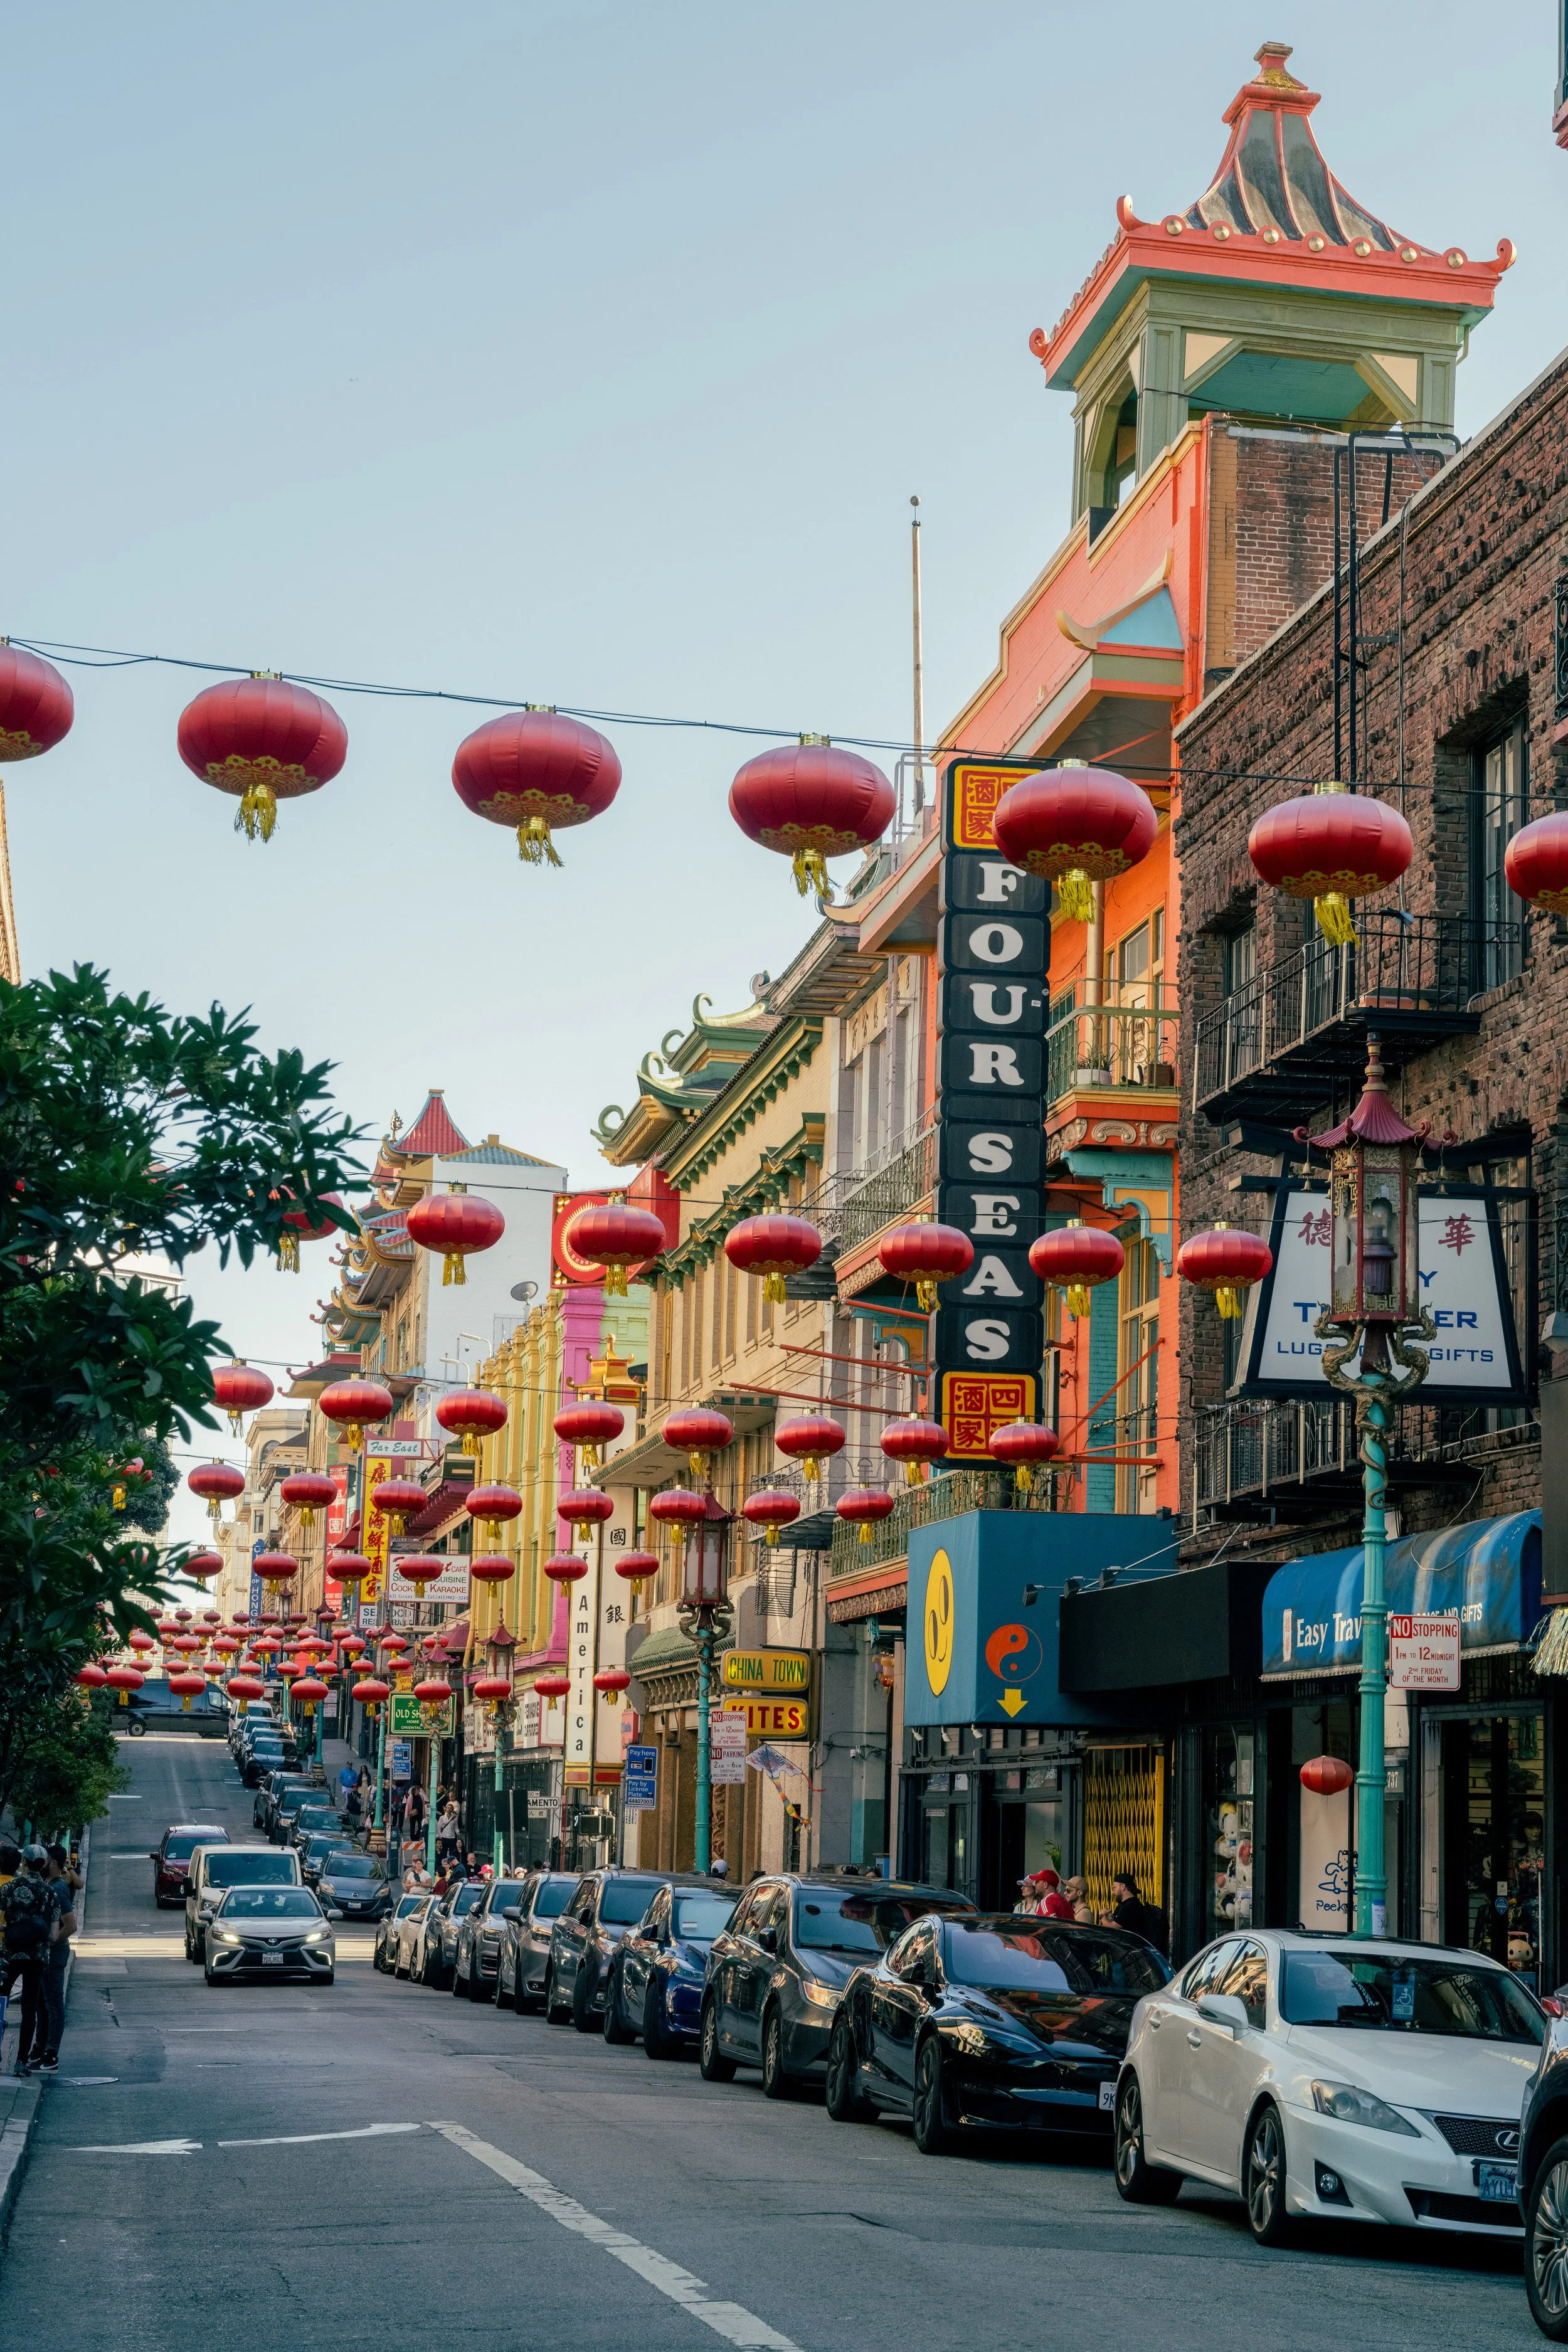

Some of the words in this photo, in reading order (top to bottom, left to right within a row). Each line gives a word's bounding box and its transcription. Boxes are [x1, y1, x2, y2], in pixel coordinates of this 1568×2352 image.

[968, 861, 1027, 1086] FOUR
[963, 1132, 1023, 1360] SEAS
[1429, 1348, 1493, 1362] GIFTS
[371, 1441, 389, 1453] Far
[393, 1442, 418, 1453] East
[365, 1462, 386, 1597] 康海鮮酒家
[452, 1565, 467, 1573] CAFÉ
[430, 1584, 467, 1593] KARAOKE
[250, 1586, 259, 1616] HONG
[1461, 1602, 1483, 1623] GIFTS
[1296, 1618, 1328, 1653] Easy
[1333, 1610, 1394, 1643] Travr
[1393, 1618, 1411, 1636] NO
[1413, 1623, 1458, 1638] STOPPING
[576, 1595, 588, 1752] America
[729, 1657, 763, 1681] CHINA
[773, 1659, 805, 1683] TOWN
[395, 1709, 410, 1719] OLD
[712, 1712, 722, 1722] NO
[731, 1706, 800, 1730] ITES
[711, 1749, 721, 1758] NO
[1387, 1771, 1399, 1788] 737
